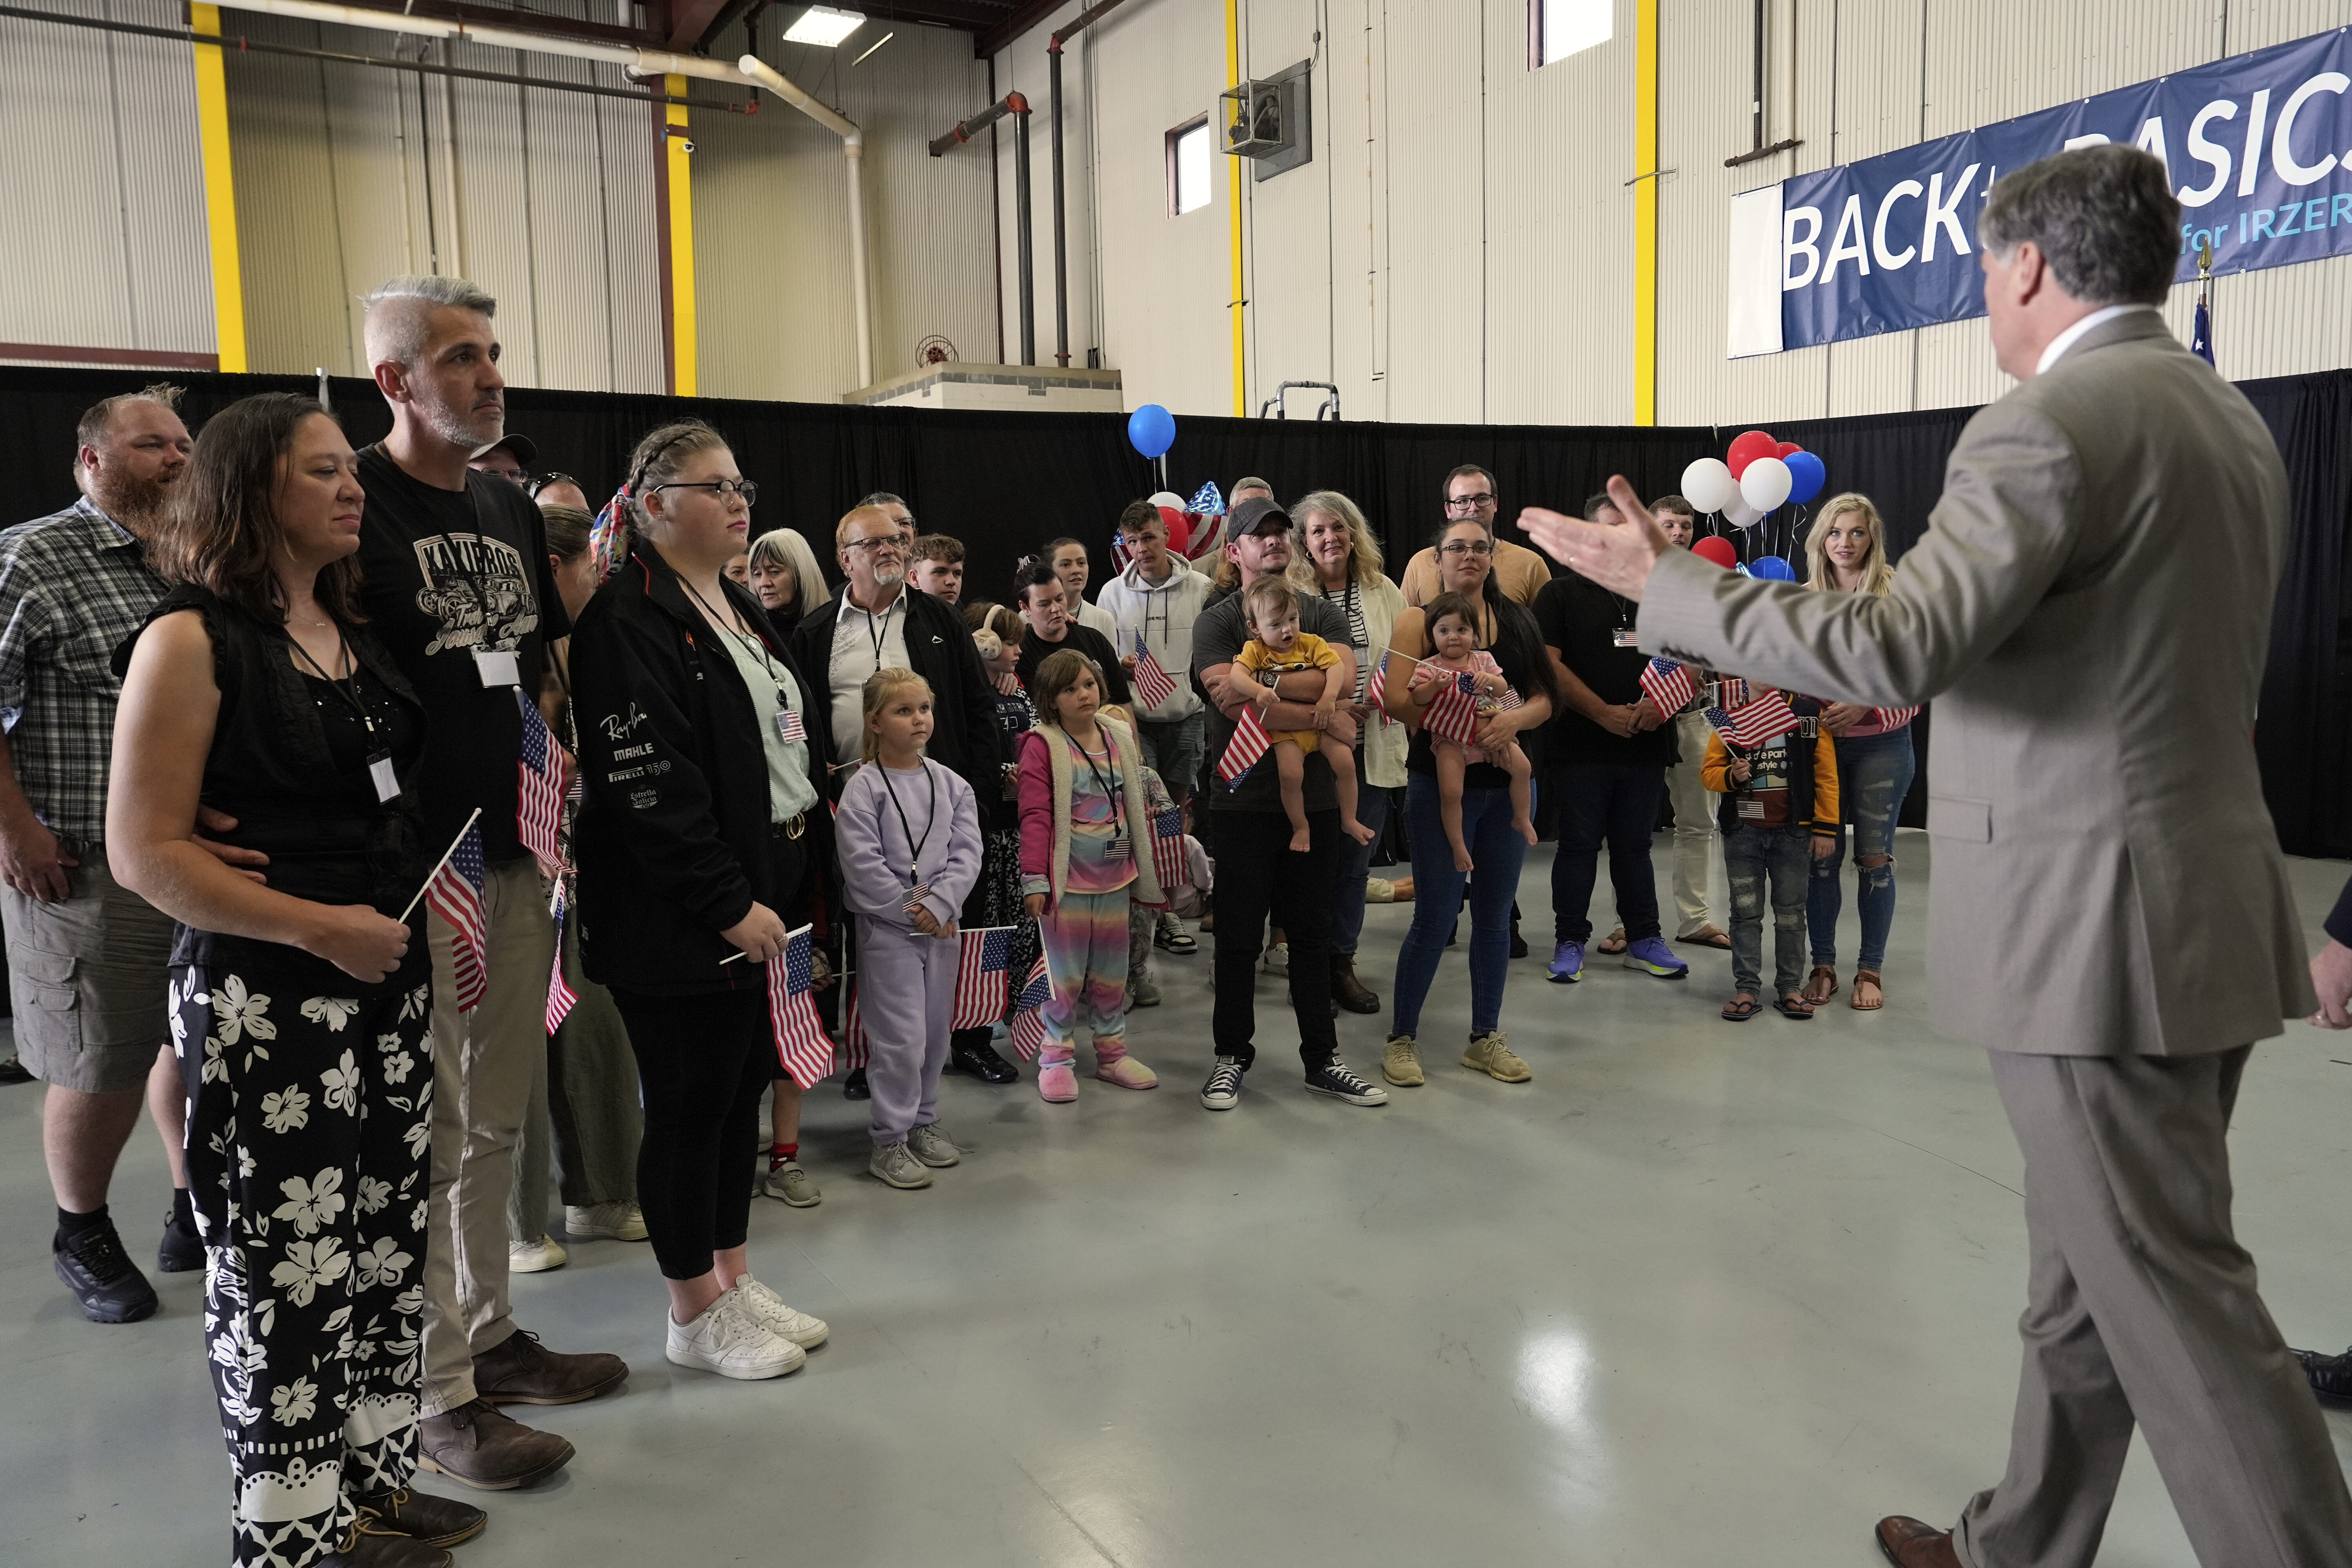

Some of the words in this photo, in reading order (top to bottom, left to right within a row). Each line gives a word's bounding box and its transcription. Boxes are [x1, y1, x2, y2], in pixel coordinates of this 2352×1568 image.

[1782, 162, 1981, 291] BACK
[2064, 72, 2352, 207] ASIC
[2180, 223, 2229, 254] for
[613, 742, 654, 761] MAHLE
[608, 767, 644, 782] PIRELLI
[630, 789, 657, 799] Estrella
[633, 796, 657, 806] Galicia
